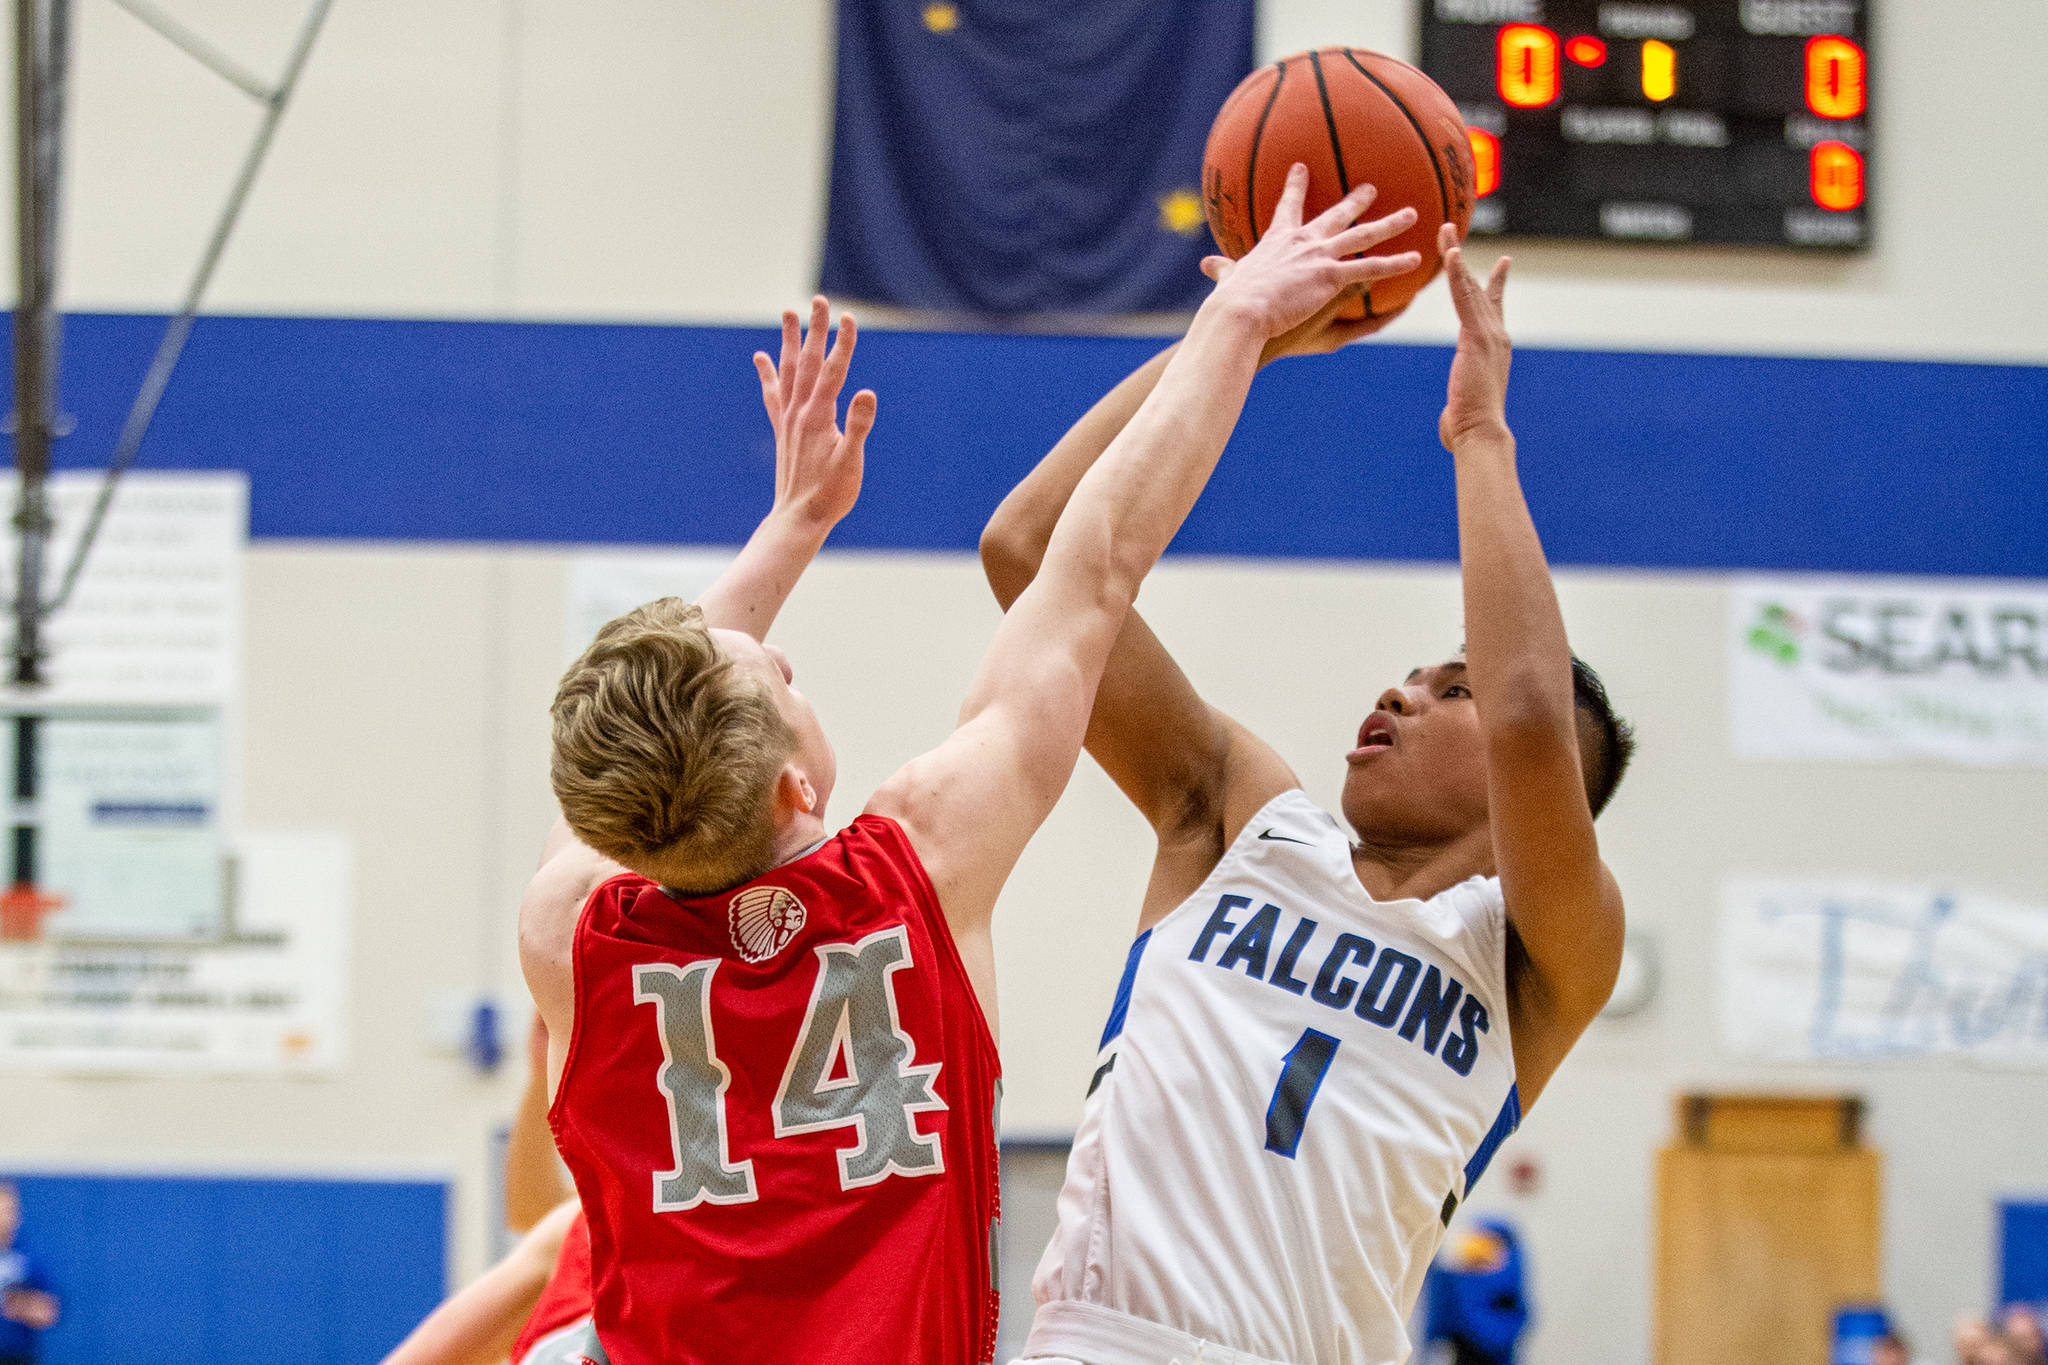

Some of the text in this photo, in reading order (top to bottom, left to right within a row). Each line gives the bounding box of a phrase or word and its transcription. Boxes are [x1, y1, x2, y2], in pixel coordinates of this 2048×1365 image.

[1496, 22, 1561, 108] 0
[1641, 39, 1676, 102] 1
[1804, 34, 1867, 119] 0
[1188, 894, 1490, 1077] FALCONS
[632, 924, 949, 1213] 14
[1264, 1027, 1341, 1160] 1
